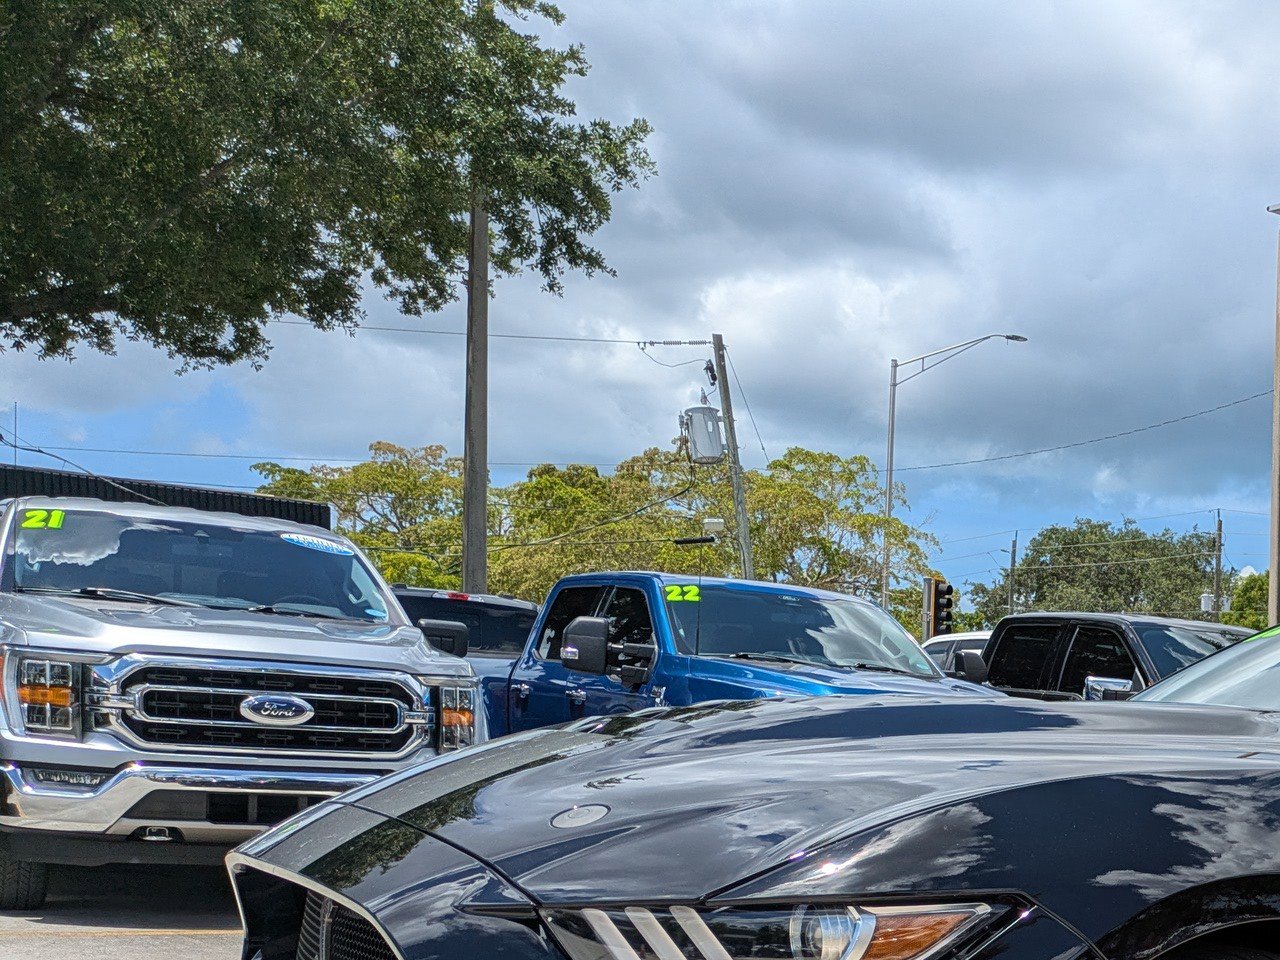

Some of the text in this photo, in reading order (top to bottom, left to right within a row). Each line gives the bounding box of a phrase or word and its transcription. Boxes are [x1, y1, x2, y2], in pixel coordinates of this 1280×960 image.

[21, 509, 65, 529] 21
[665, 585, 701, 602] 22
[260, 701, 296, 717] Ford
